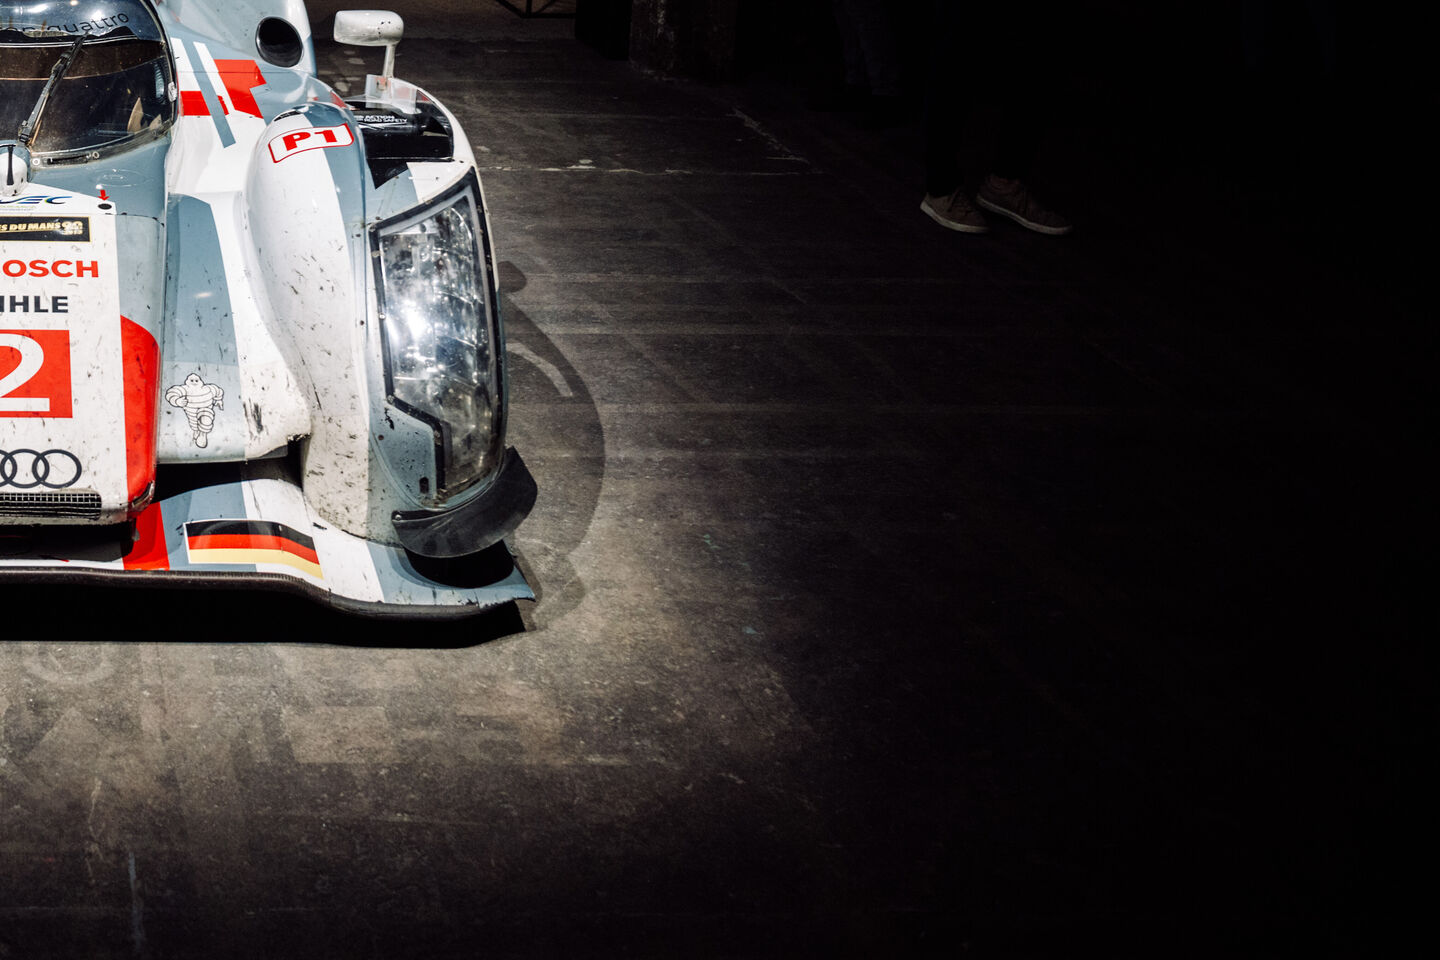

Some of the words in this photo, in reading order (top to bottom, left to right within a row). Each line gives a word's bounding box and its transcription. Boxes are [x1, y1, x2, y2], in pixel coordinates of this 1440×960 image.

[47, 11, 130, 35] quattro
[282, 130, 337, 151] P1
[10, 223, 27, 232] DU
[27, 222, 62, 231] MANS
